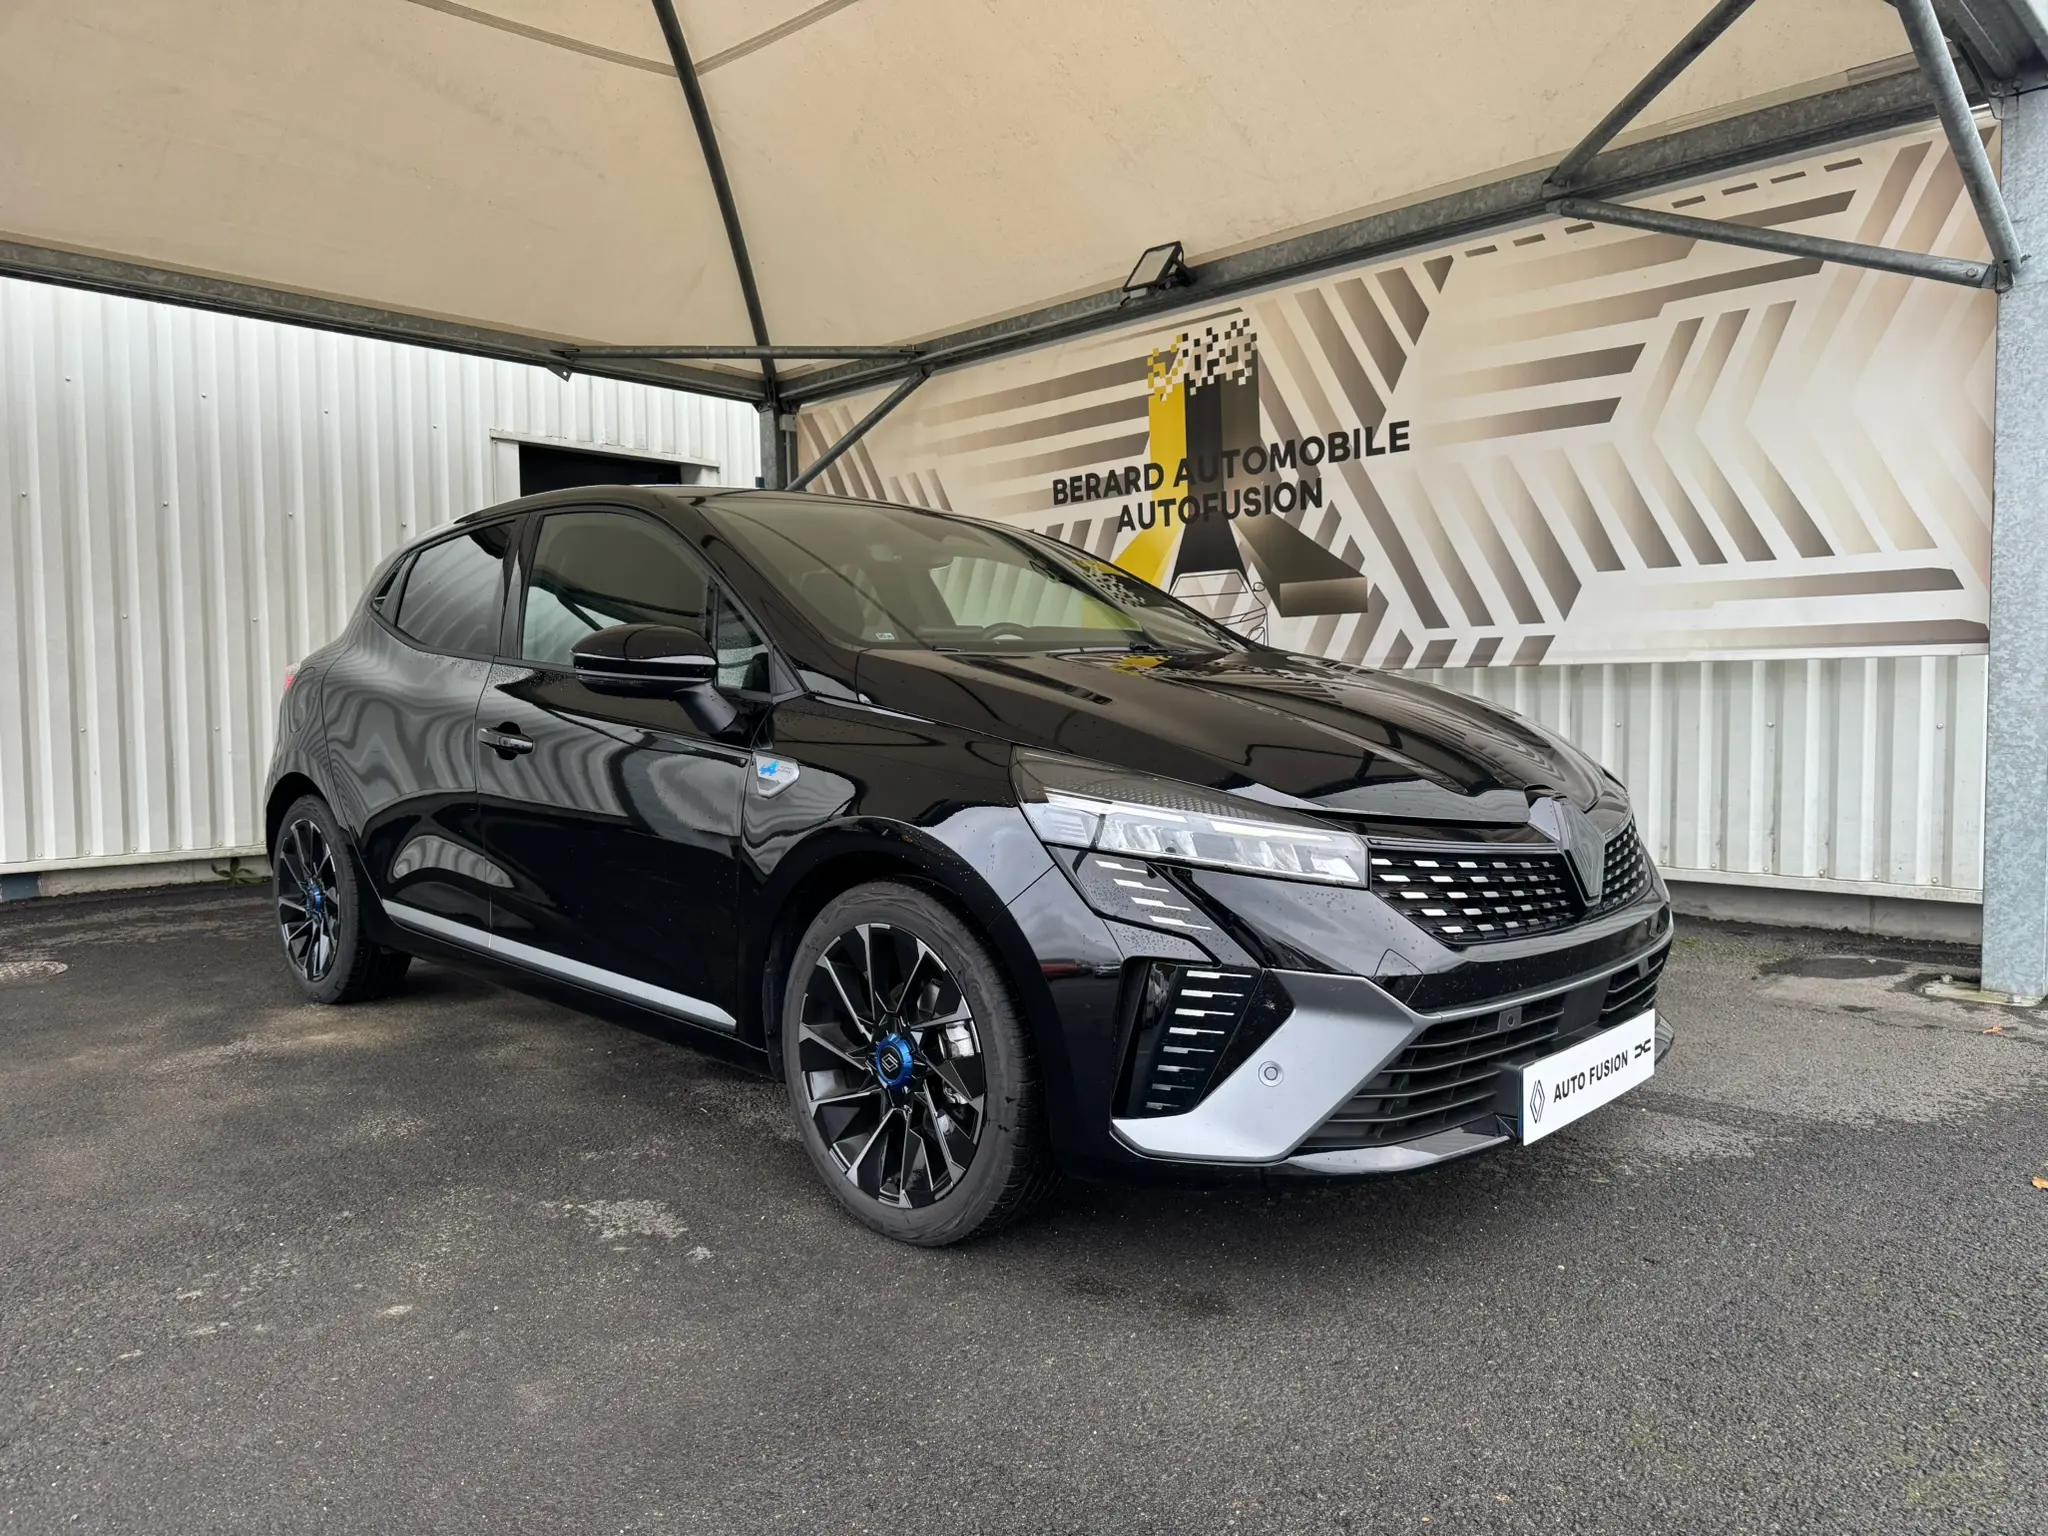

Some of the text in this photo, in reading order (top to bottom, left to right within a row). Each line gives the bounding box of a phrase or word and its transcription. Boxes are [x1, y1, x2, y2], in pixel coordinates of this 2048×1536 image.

[1053, 420, 1411, 505] BERARD AUTOMOBILE
[1117, 477, 1323, 533] AUTOFUSION
[1553, 1049, 1628, 1103] AUTO FUSION
